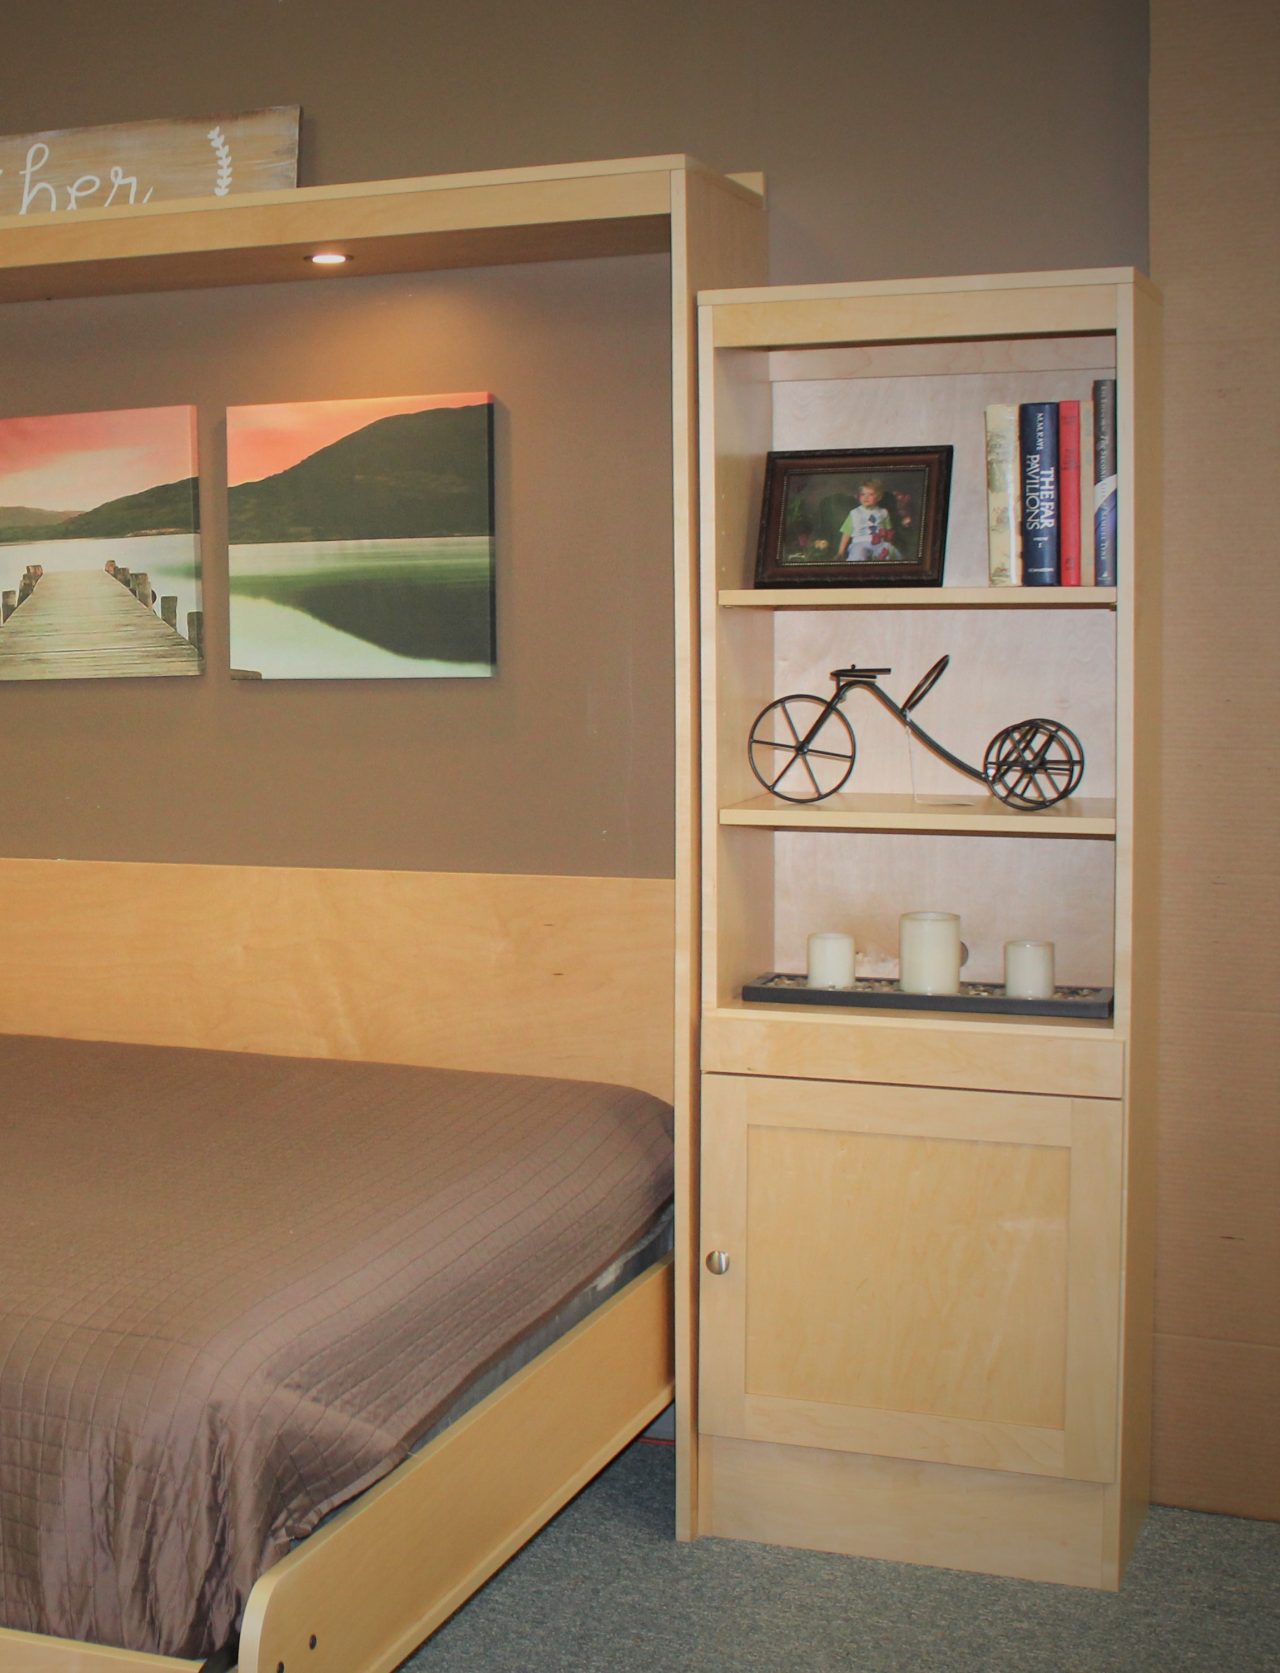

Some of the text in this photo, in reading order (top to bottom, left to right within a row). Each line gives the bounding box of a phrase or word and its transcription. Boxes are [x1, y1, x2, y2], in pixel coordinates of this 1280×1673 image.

[1026, 454, 1040, 530] PAVILIONS
[1040, 466, 1055, 500] THE
[1040, 501, 1055, 530] FAR
